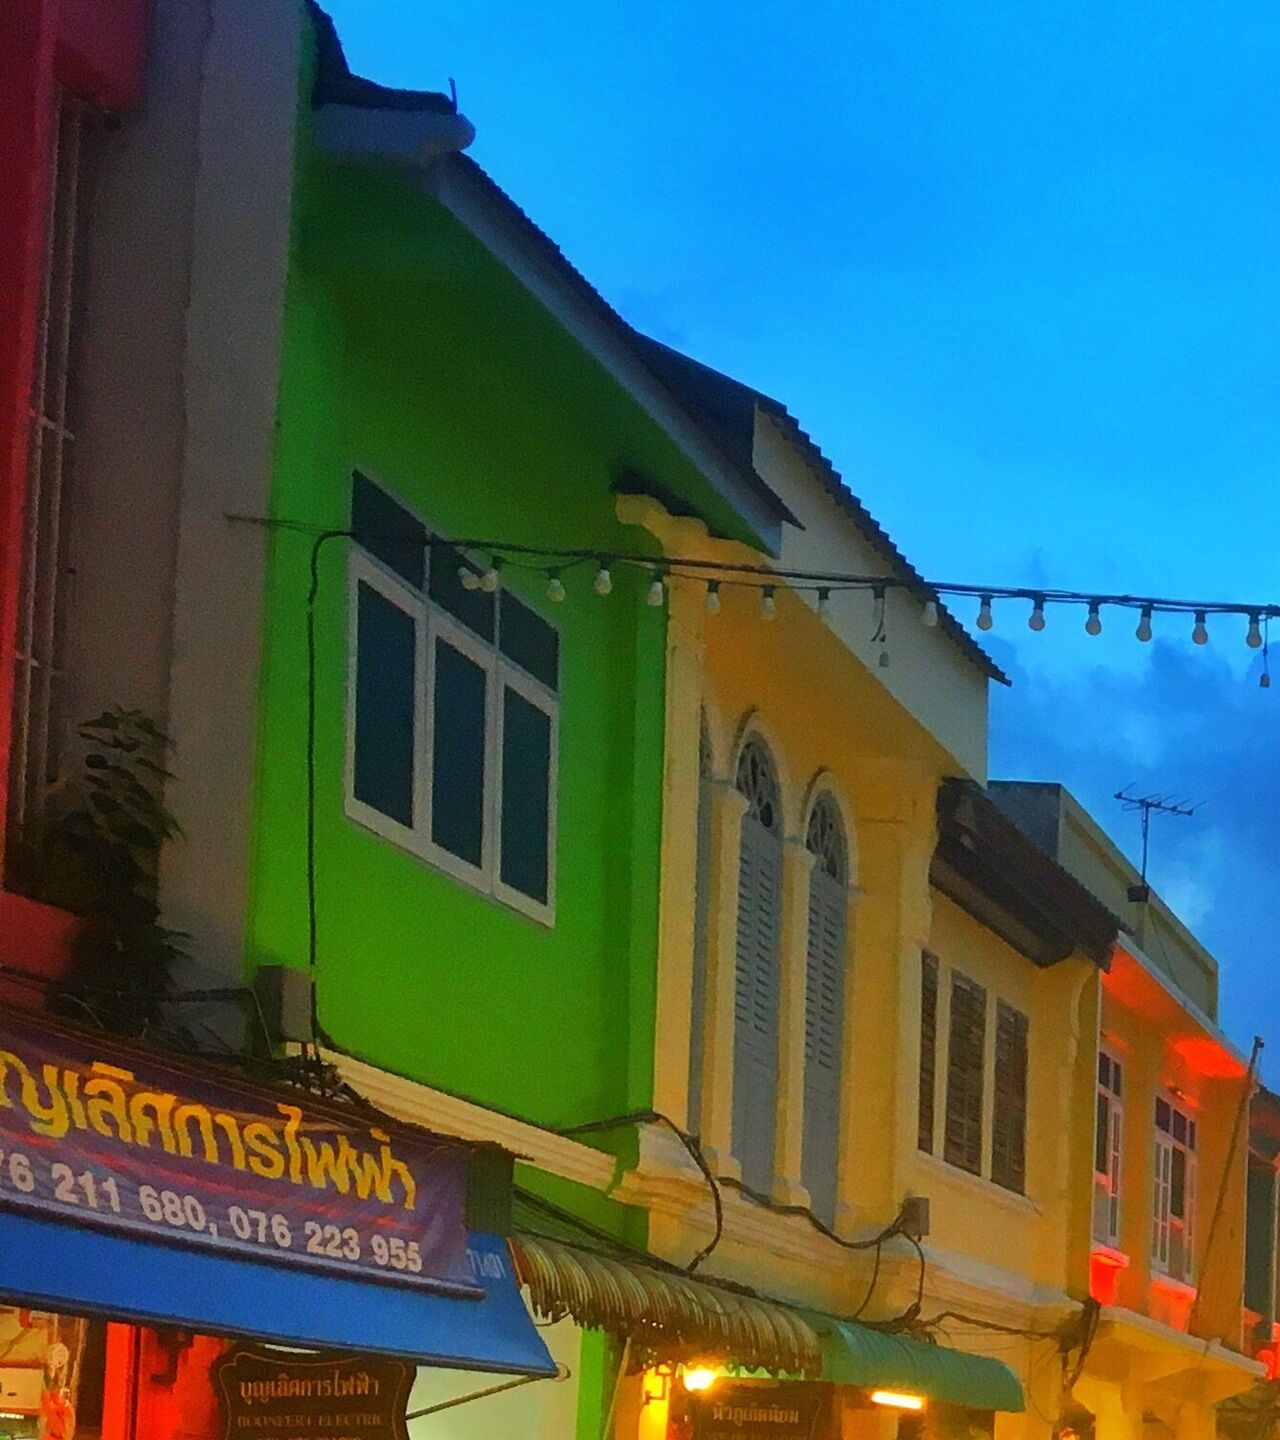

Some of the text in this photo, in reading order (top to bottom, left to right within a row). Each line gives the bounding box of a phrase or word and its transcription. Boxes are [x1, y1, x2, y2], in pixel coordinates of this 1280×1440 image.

[0, 1151, 36, 1193] 6
[51, 1162, 121, 1213] 211
[139, 1184, 218, 1241] 680,
[228, 1205, 292, 1248] 076
[304, 1220, 361, 1261] 223
[371, 1234, 423, 1273] 955
[317, 1413, 383, 1427] ELECTRIC
